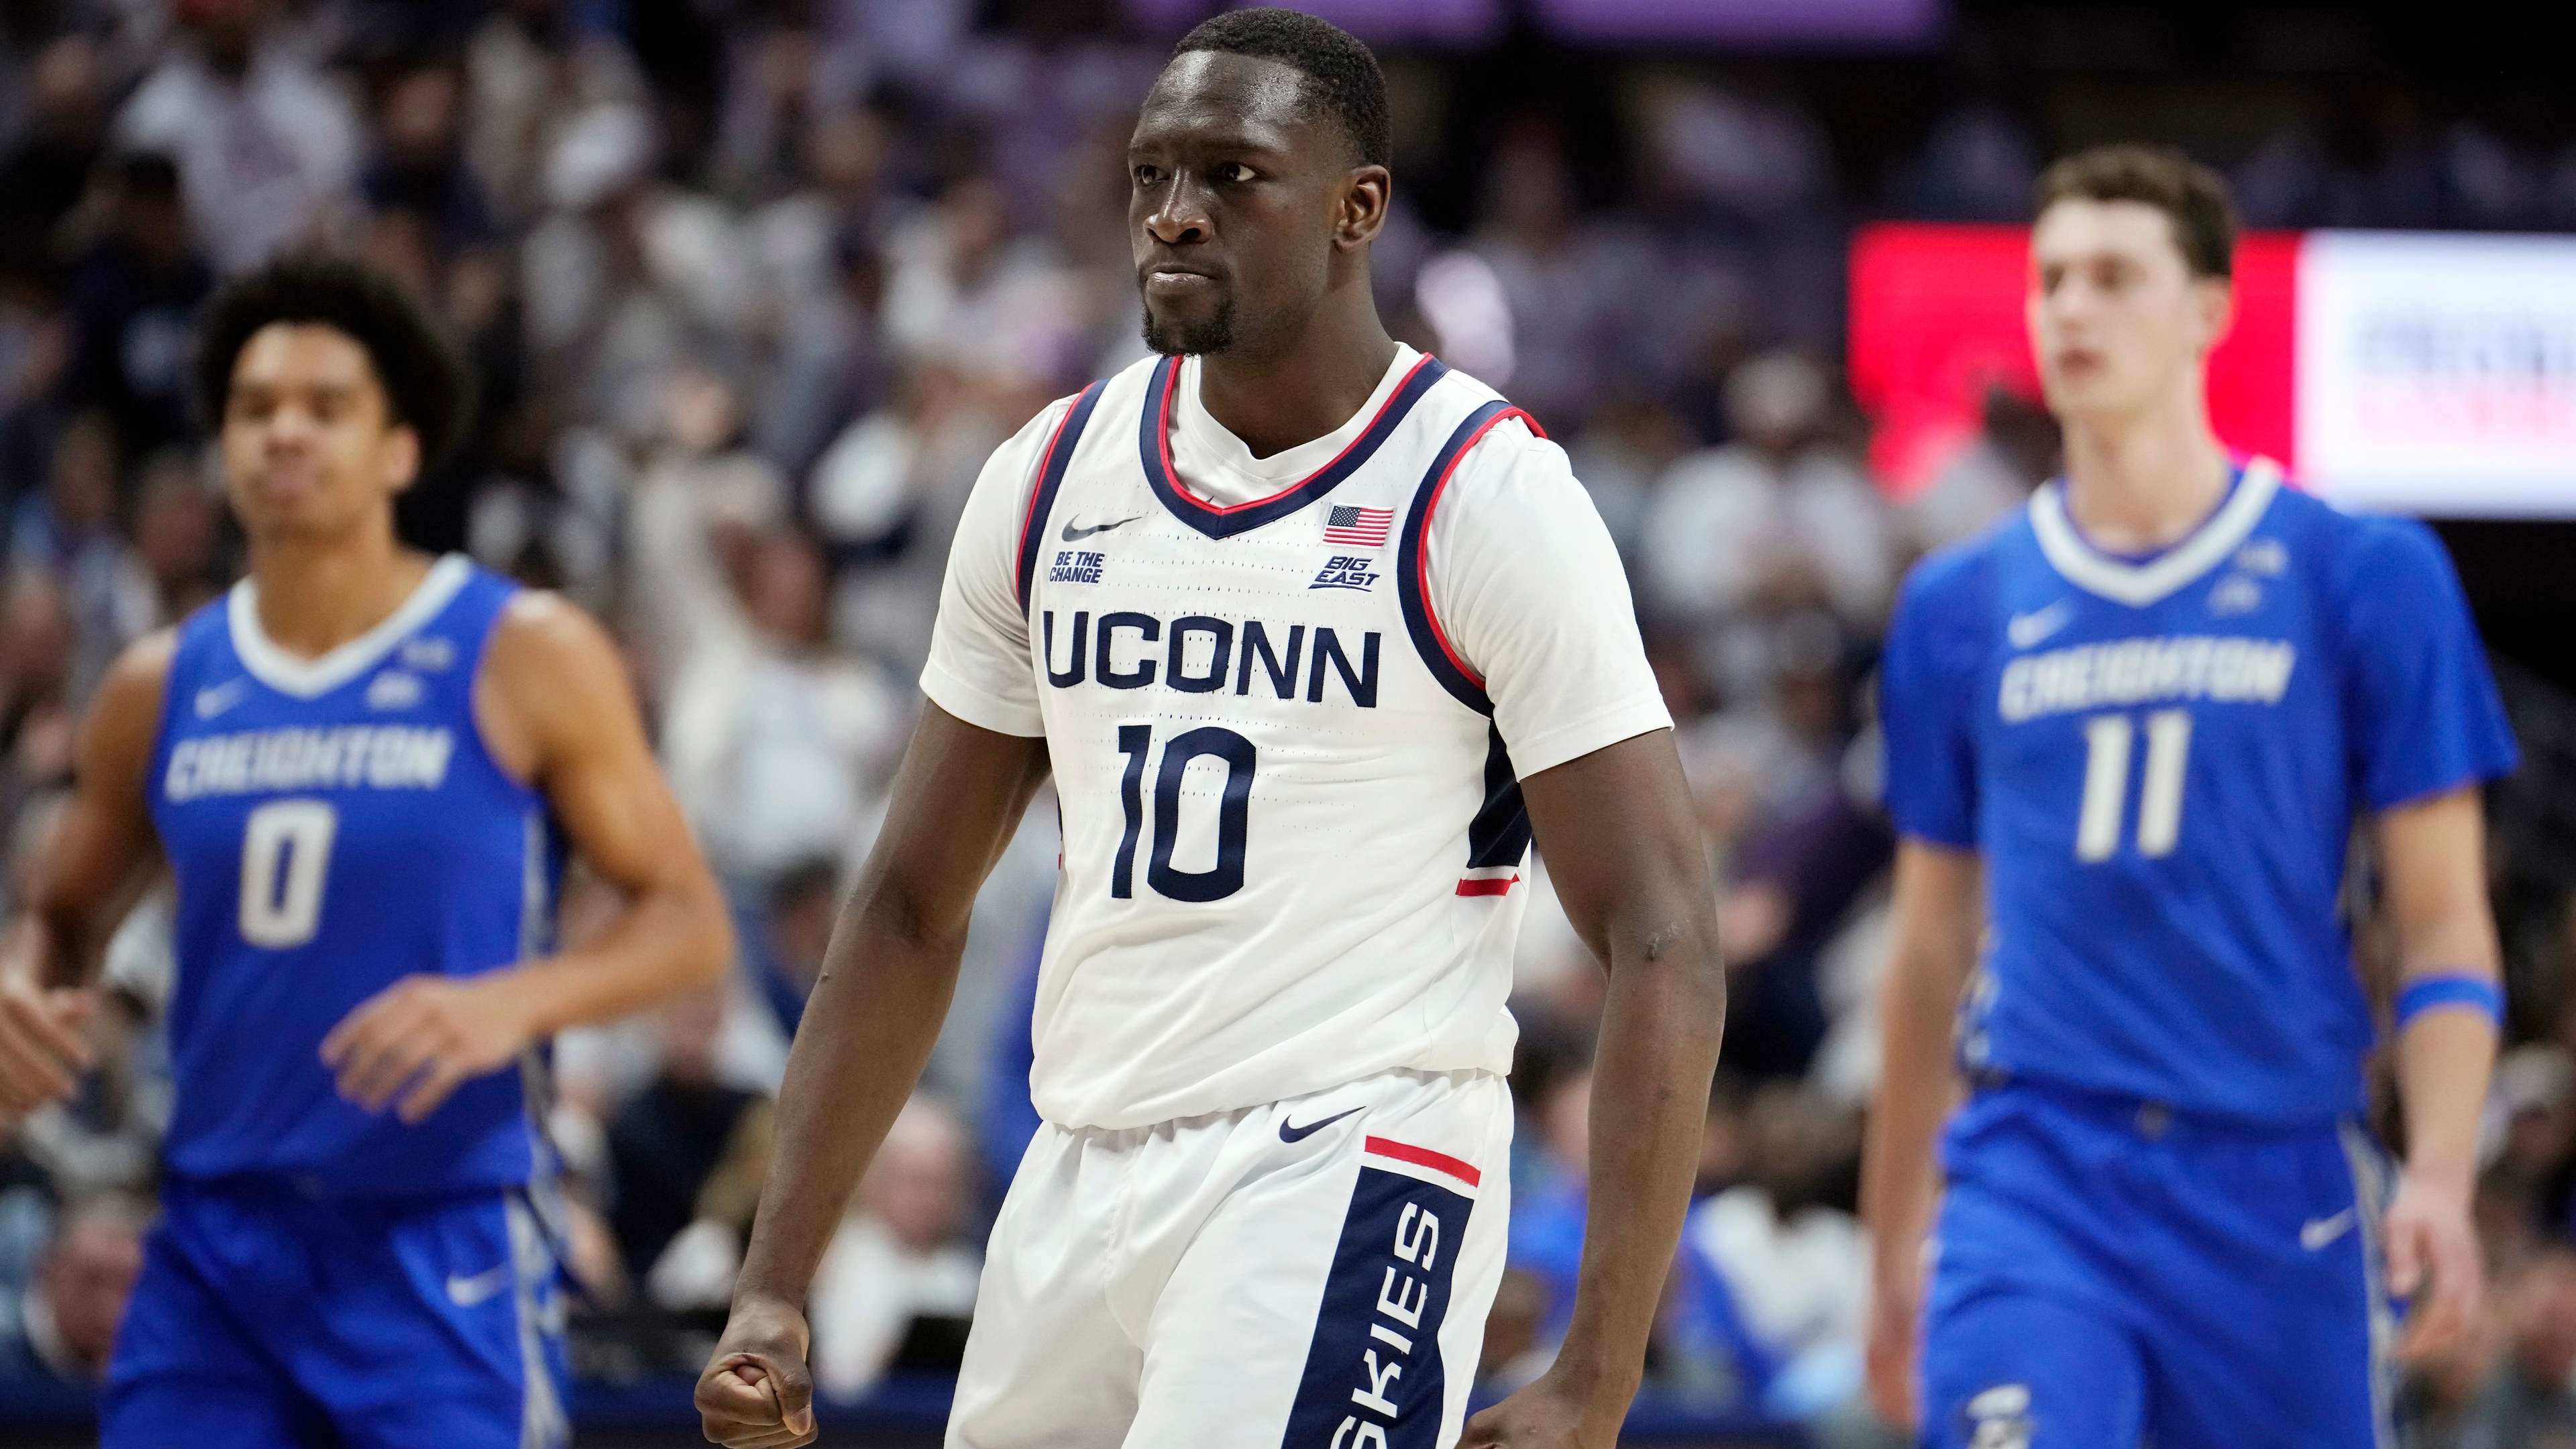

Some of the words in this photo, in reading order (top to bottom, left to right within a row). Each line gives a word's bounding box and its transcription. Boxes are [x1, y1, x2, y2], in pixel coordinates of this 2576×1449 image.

[1049, 567, 1103, 584] CHANGE
[1055, 551, 1073, 566] BE
[1075, 551, 1105, 568] THE
[1314, 570, 1381, 586] EAST
[1324, 556, 1373, 570] BIG
[1043, 610, 1381, 708] UCONN
[1112, 724, 1256, 902] 10
[2078, 710, 2190, 861] 11
[239, 800, 335, 948] 0
